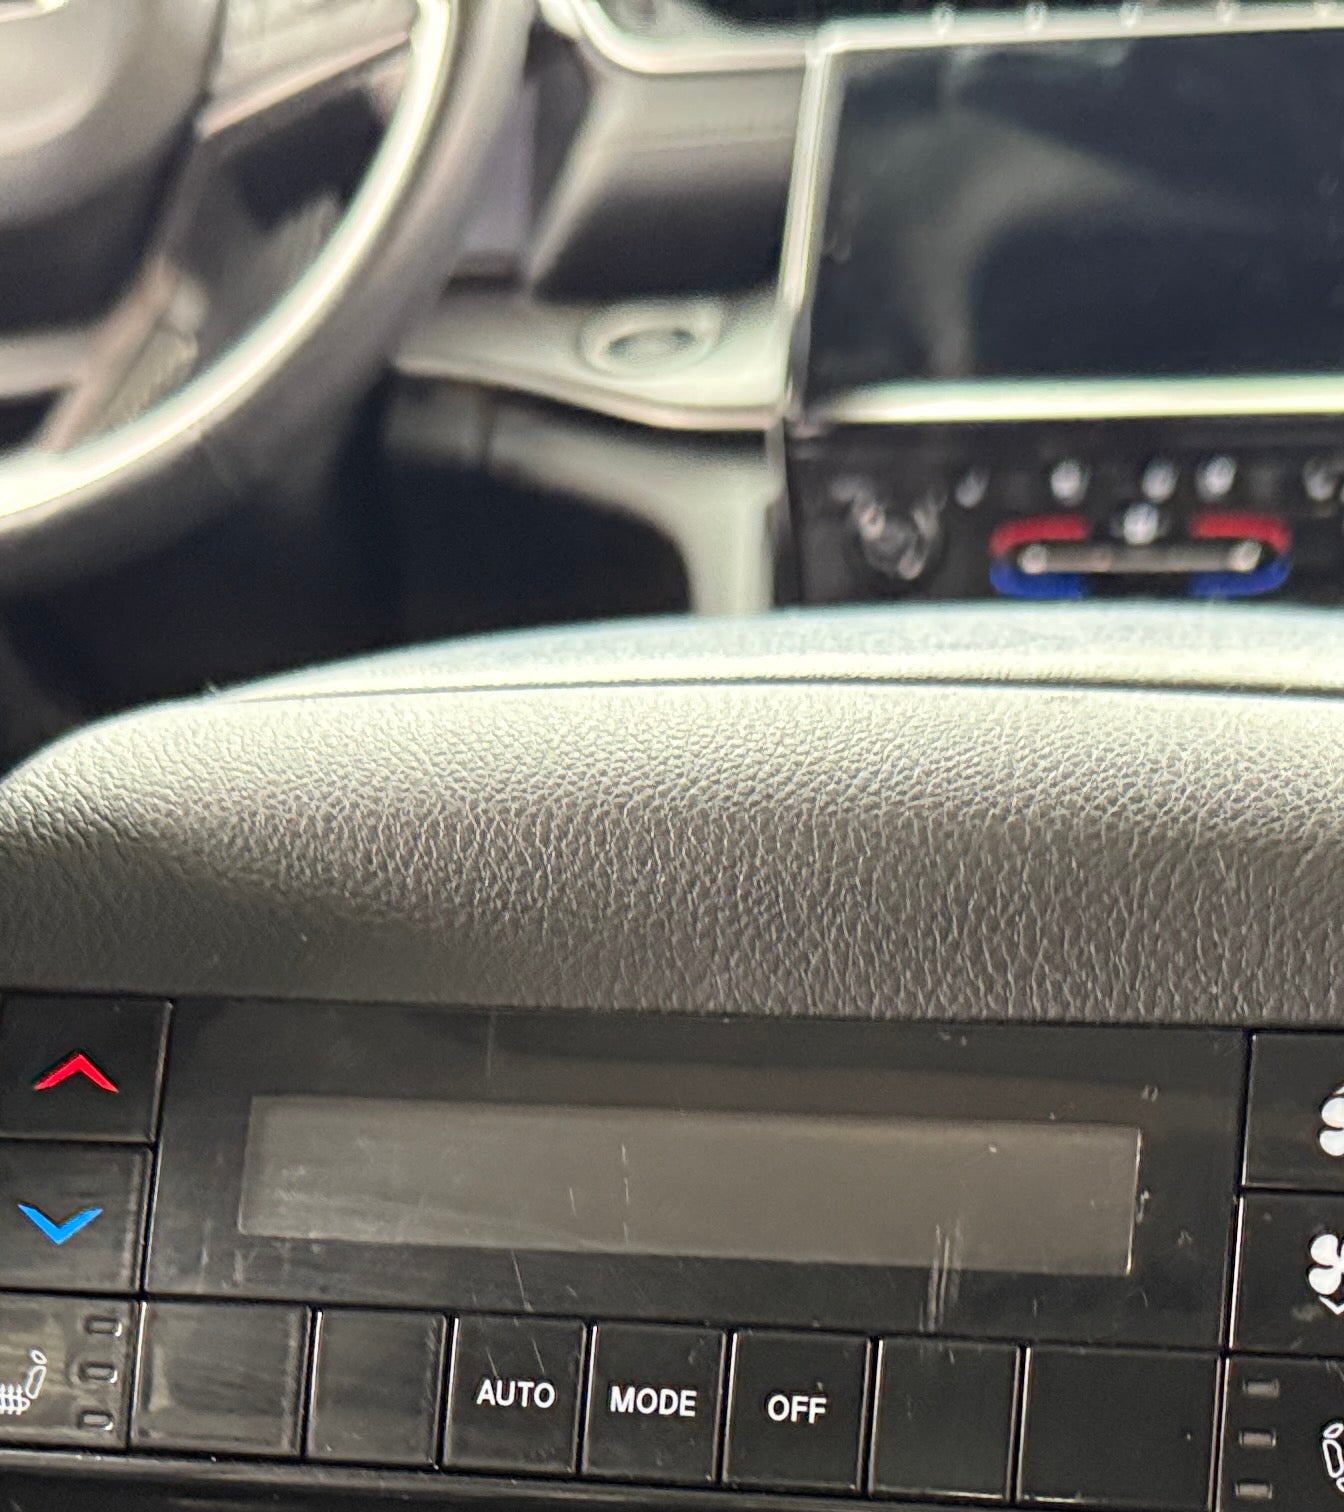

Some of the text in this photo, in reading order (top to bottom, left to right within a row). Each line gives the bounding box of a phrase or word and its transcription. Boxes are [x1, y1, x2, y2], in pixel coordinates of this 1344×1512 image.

[475, 1377, 557, 1409] AUTO
[609, 1384, 698, 1417] MODE
[767, 1393, 828, 1425] OFF
